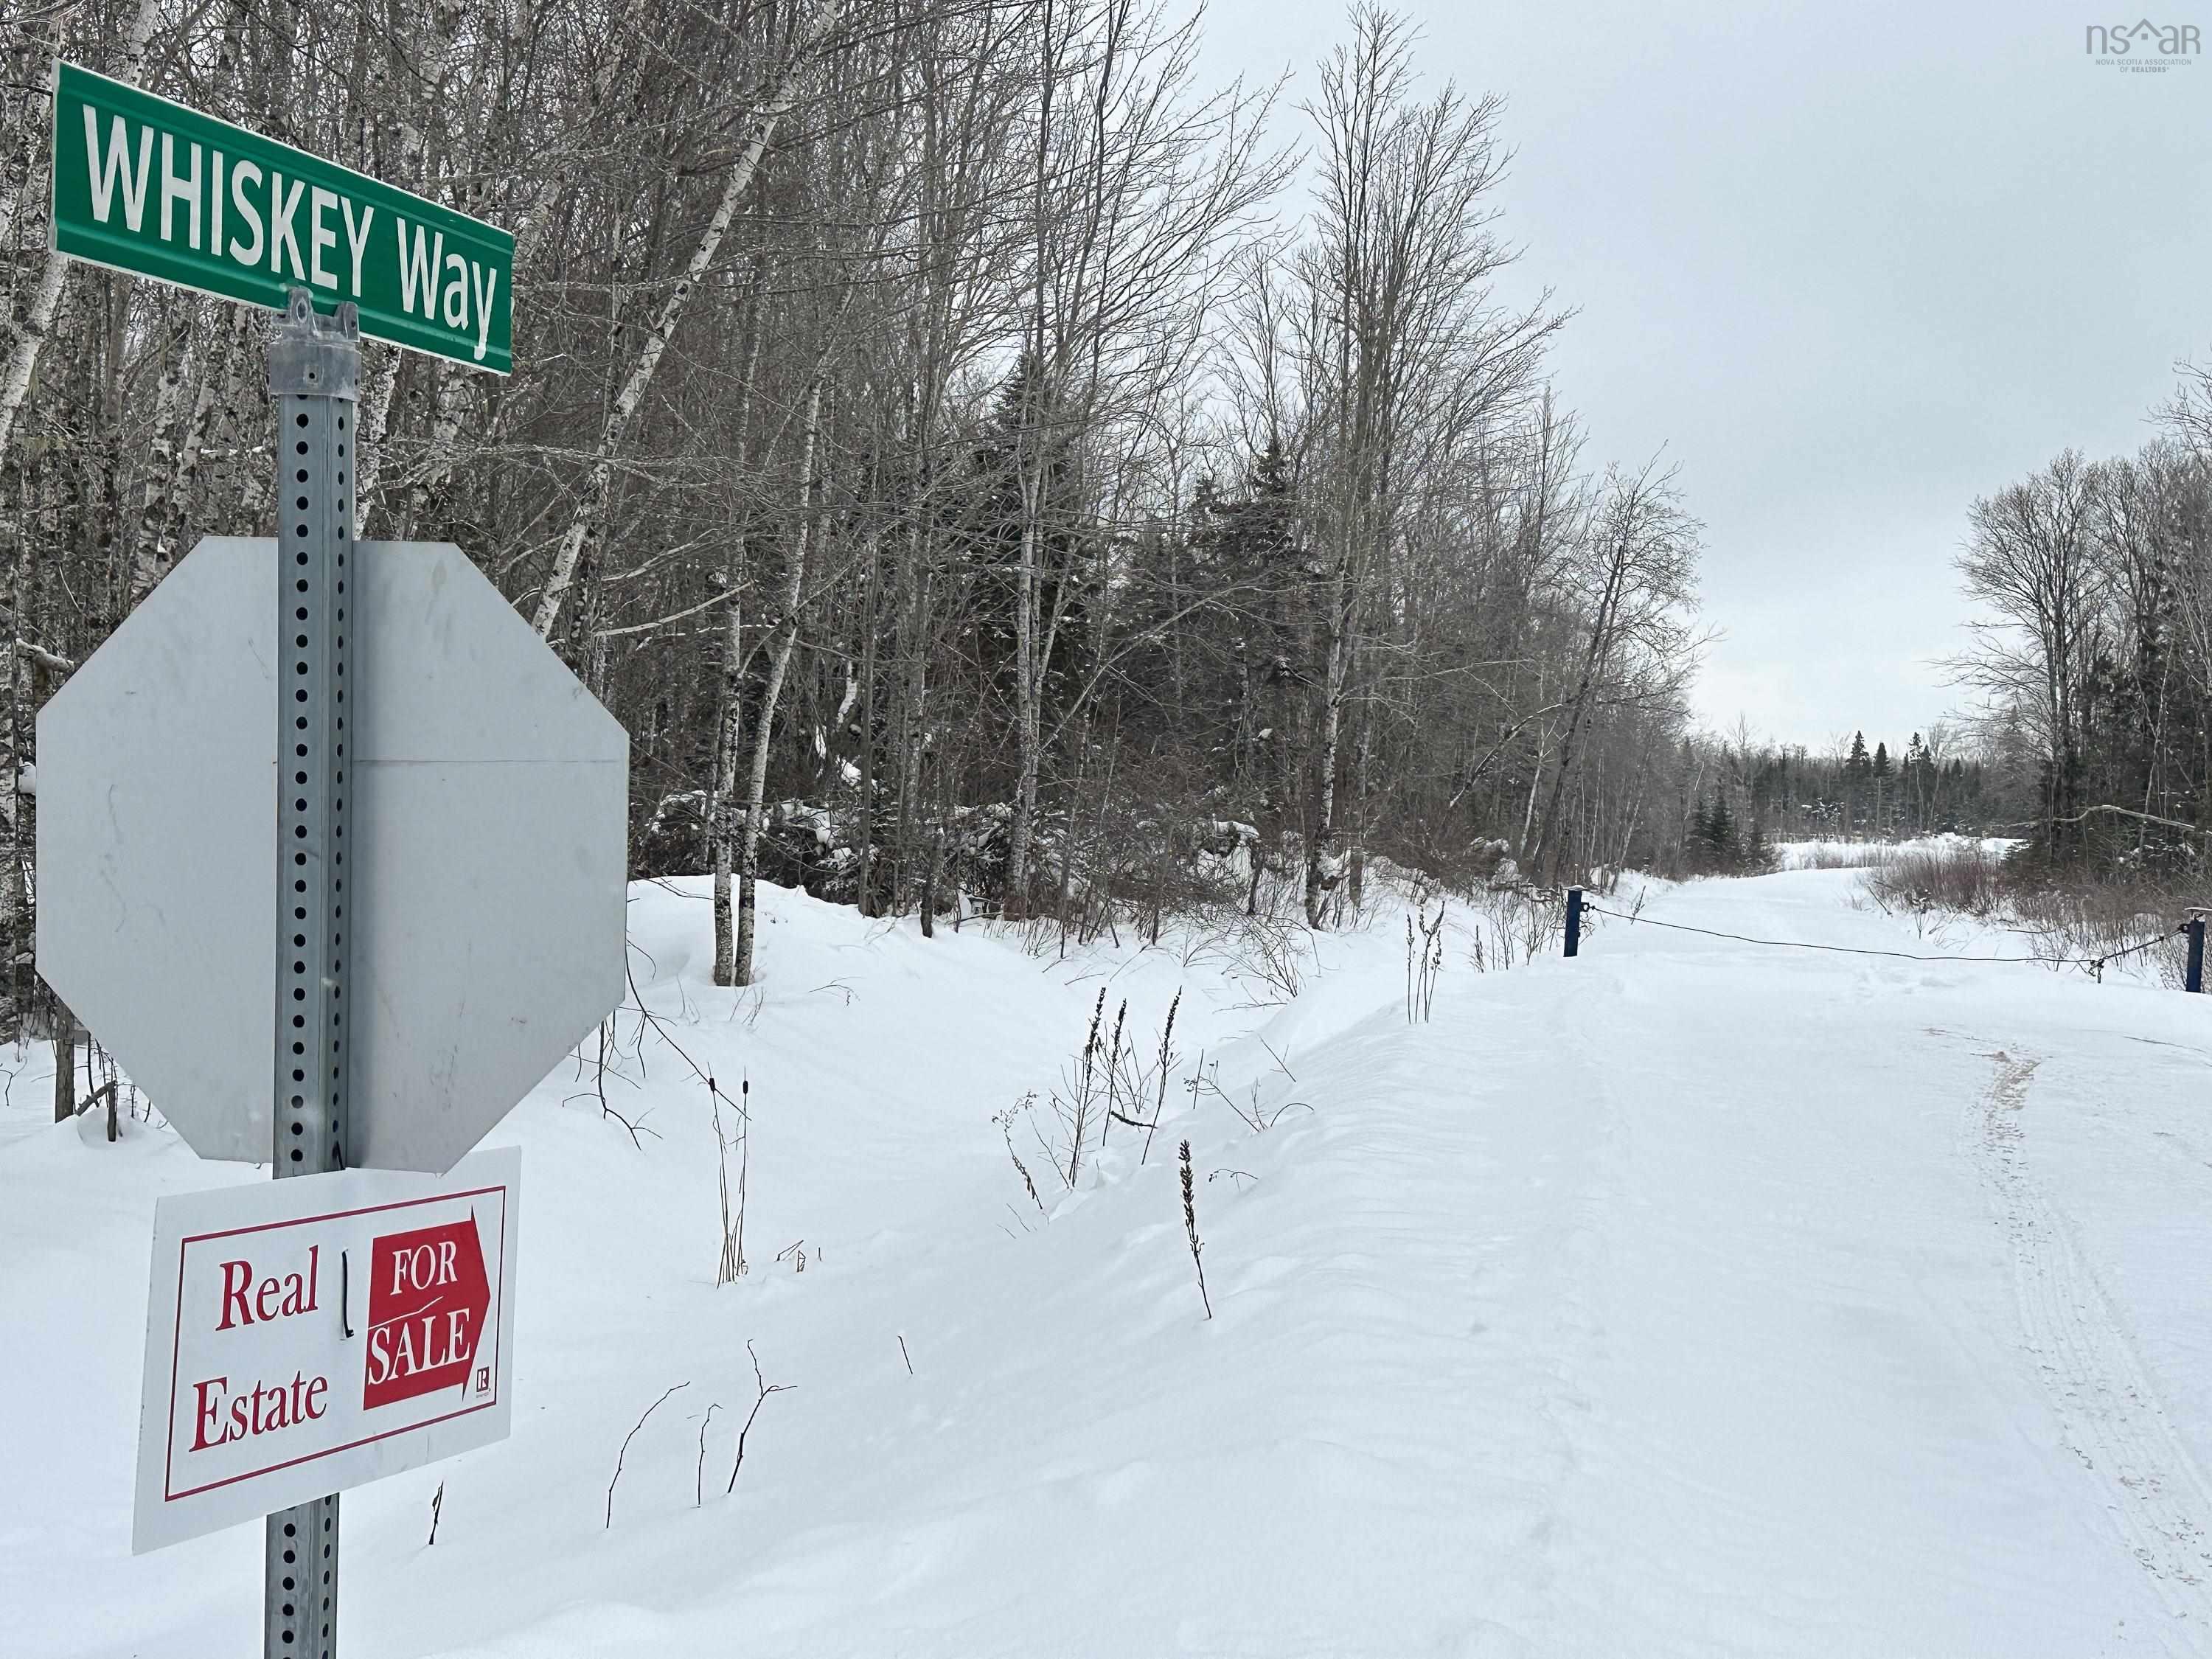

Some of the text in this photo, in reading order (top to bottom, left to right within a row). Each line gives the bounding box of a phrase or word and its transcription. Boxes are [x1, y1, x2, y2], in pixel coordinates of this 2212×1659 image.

[83, 103, 497, 361] WHISKEY Way
[215, 1244, 319, 1332] Real
[389, 1240, 459, 1295] FOR
[368, 1307, 470, 1386] SALE
[188, 1370, 329, 1453] Estate
